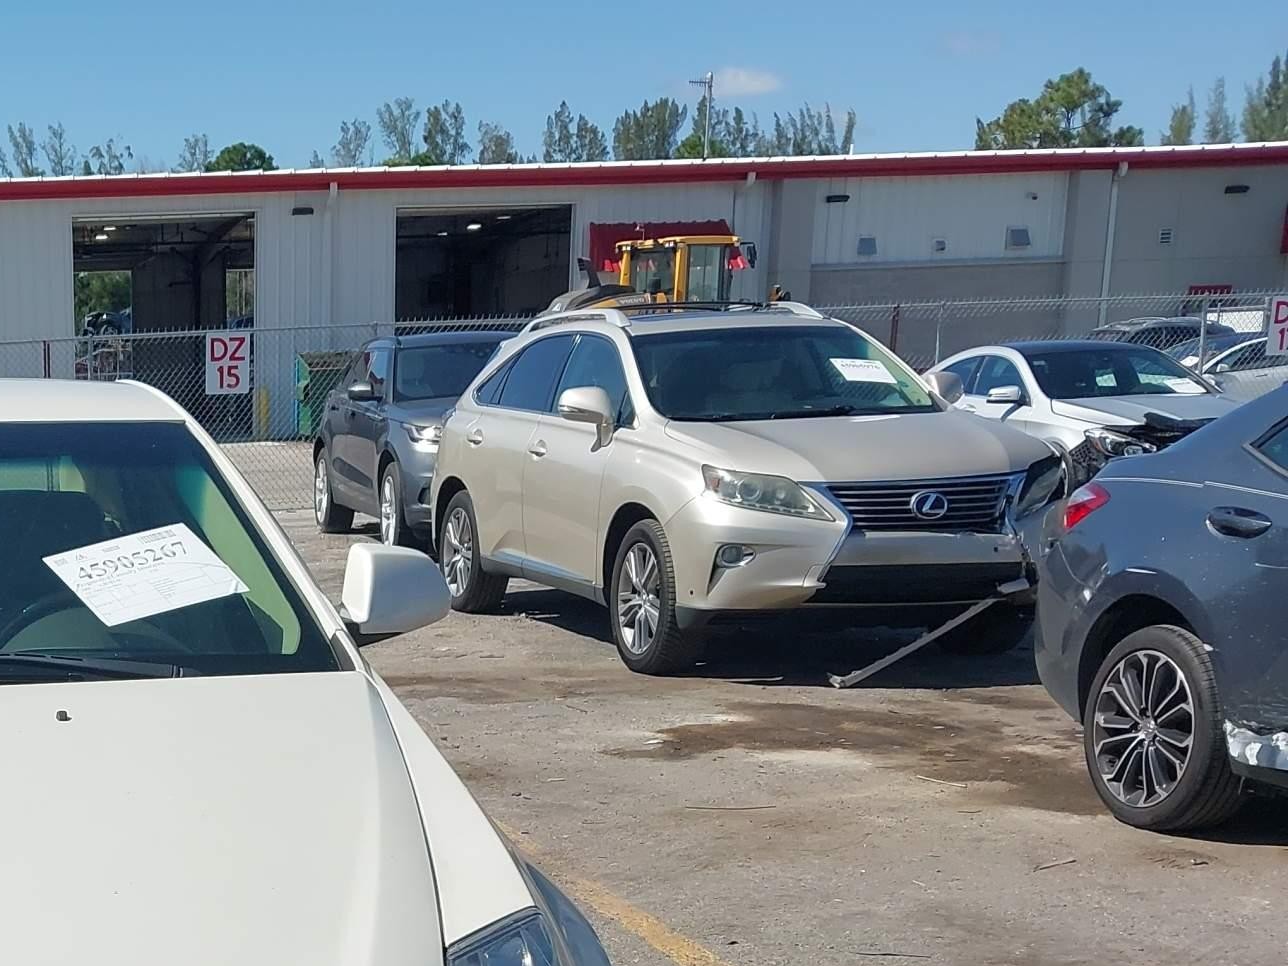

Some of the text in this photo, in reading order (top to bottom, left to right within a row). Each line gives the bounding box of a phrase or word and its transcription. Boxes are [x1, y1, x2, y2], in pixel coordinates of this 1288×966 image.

[210, 336, 246, 362] DZ
[1279, 327, 1288, 350] 1
[217, 365, 240, 389] 15
[78, 541, 187, 579] 45905267
